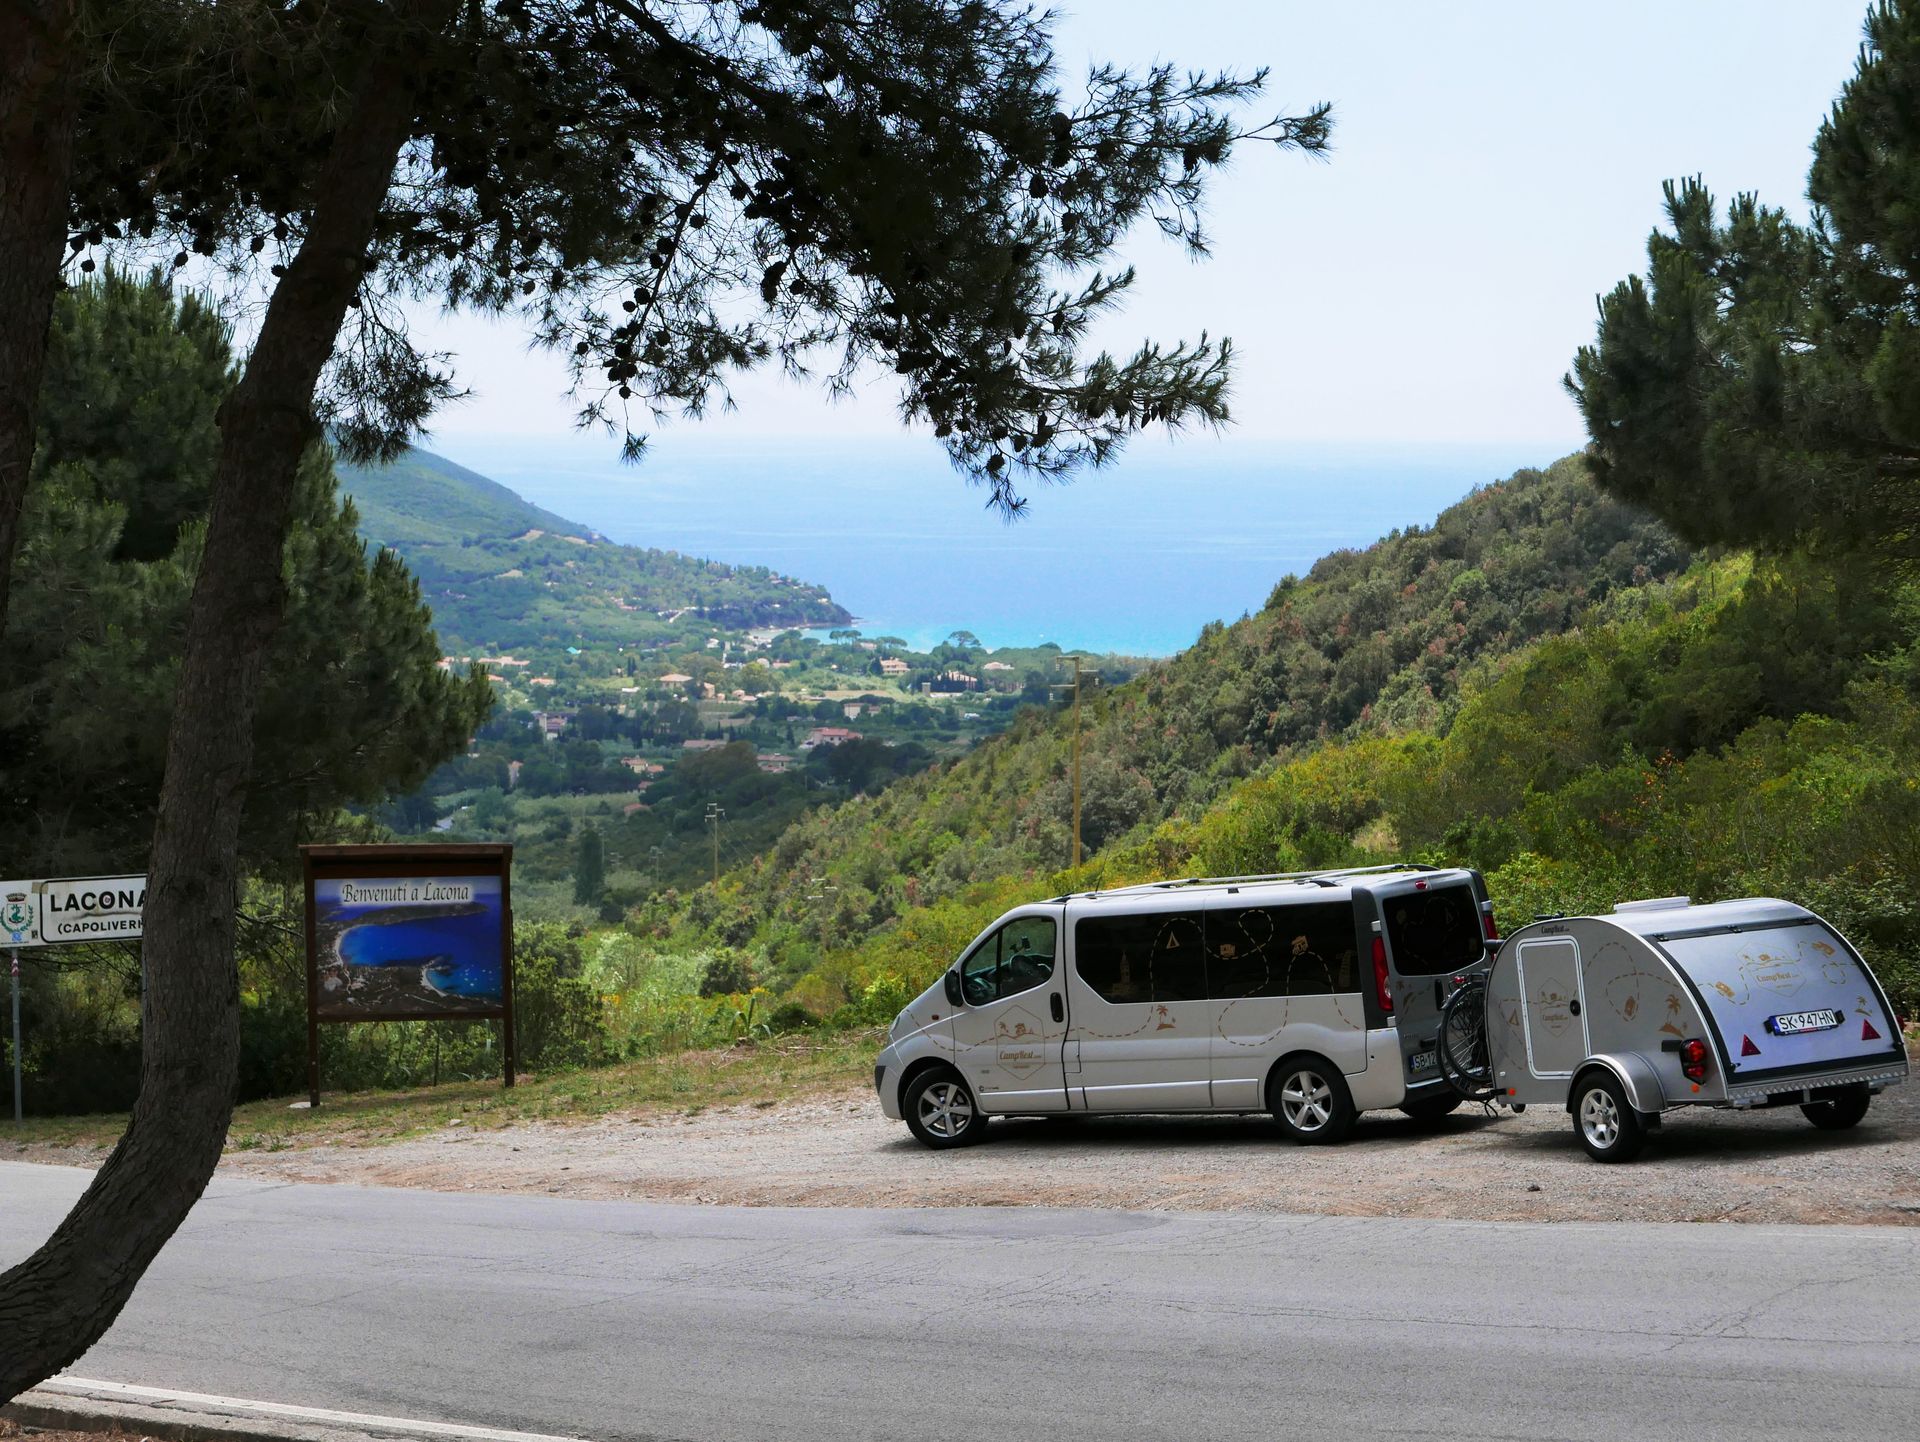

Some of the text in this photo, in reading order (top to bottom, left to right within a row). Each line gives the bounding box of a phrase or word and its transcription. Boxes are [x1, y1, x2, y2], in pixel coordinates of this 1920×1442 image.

[342, 882, 469, 902] Benvenuti a Lacona
[1779, 1016, 1798, 1030] SK
[1798, 1011, 1835, 1028] 947HN
